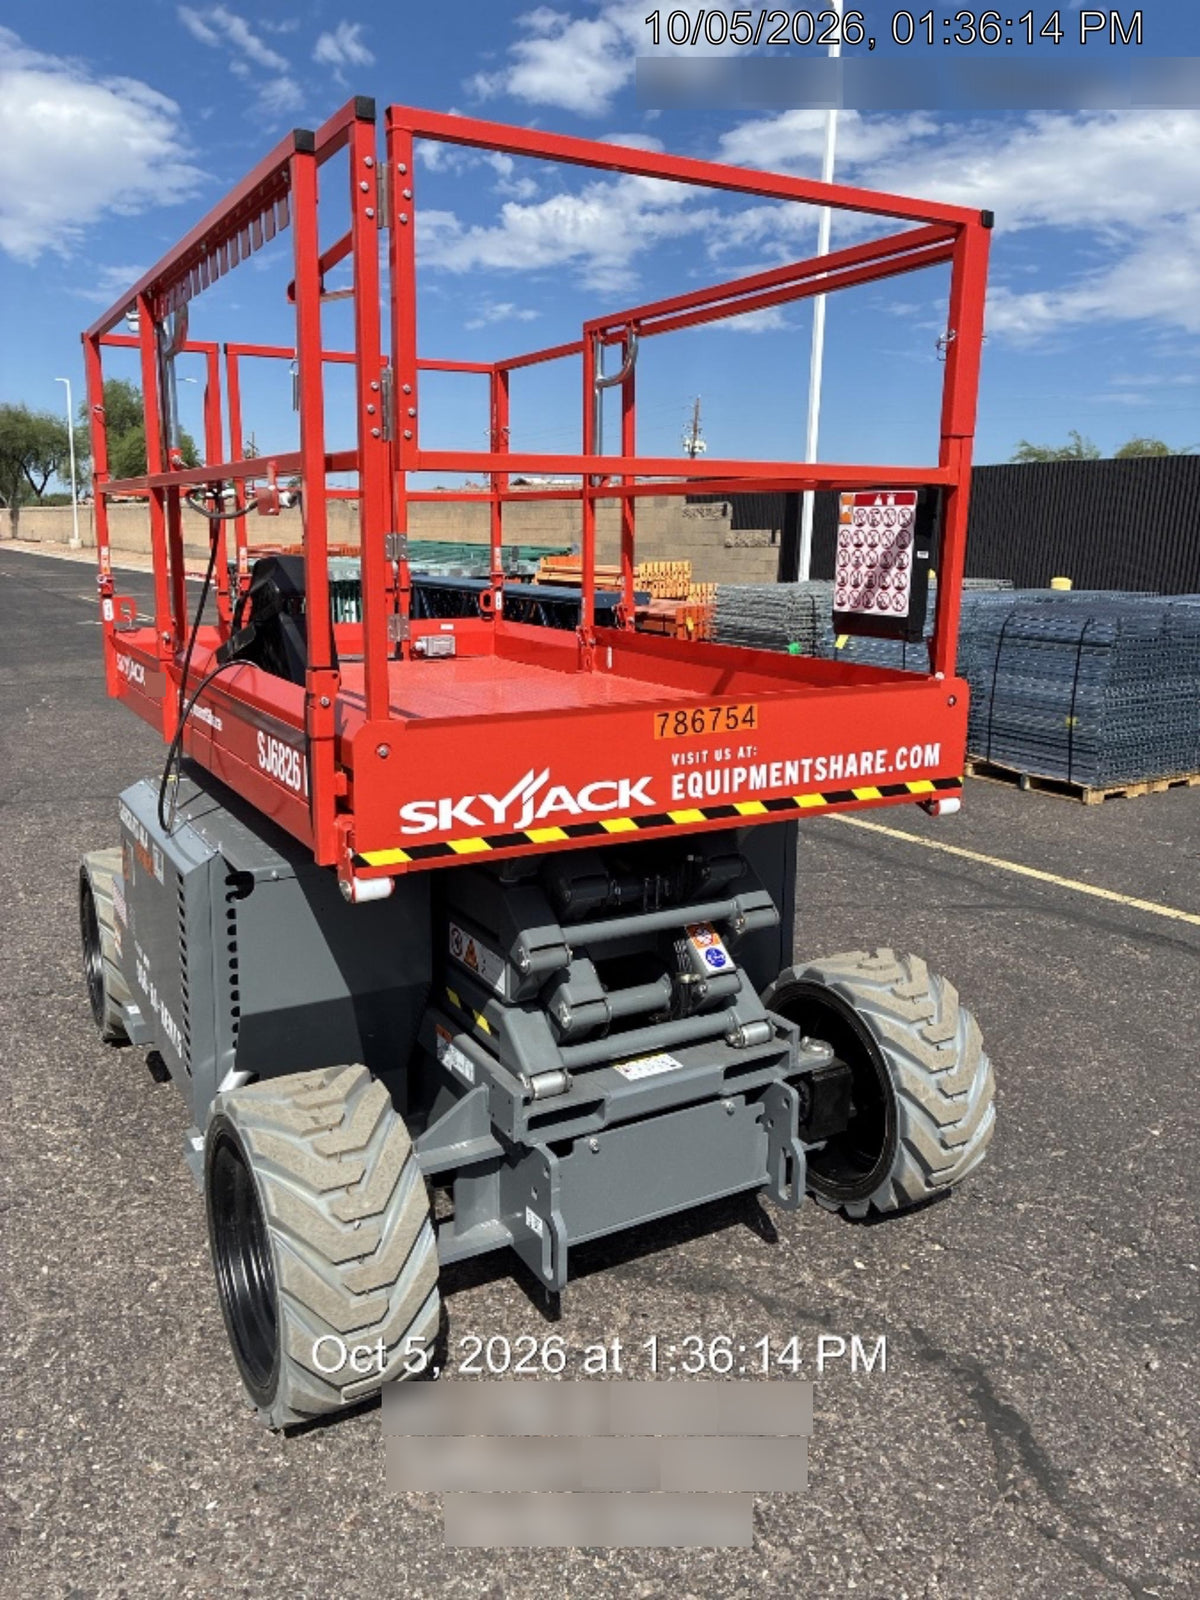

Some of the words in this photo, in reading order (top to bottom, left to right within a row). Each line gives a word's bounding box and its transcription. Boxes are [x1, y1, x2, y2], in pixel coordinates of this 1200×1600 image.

[657, 705, 756, 737] 786754
[257, 730, 301, 791] SJ6826
[671, 750, 708, 766] VISIT
[714, 748, 731, 763] US
[737, 746, 758, 759] AT:
[671, 743, 941, 800] EQUIPMENTSHARE.COM
[400, 767, 656, 834] SKYJACK
